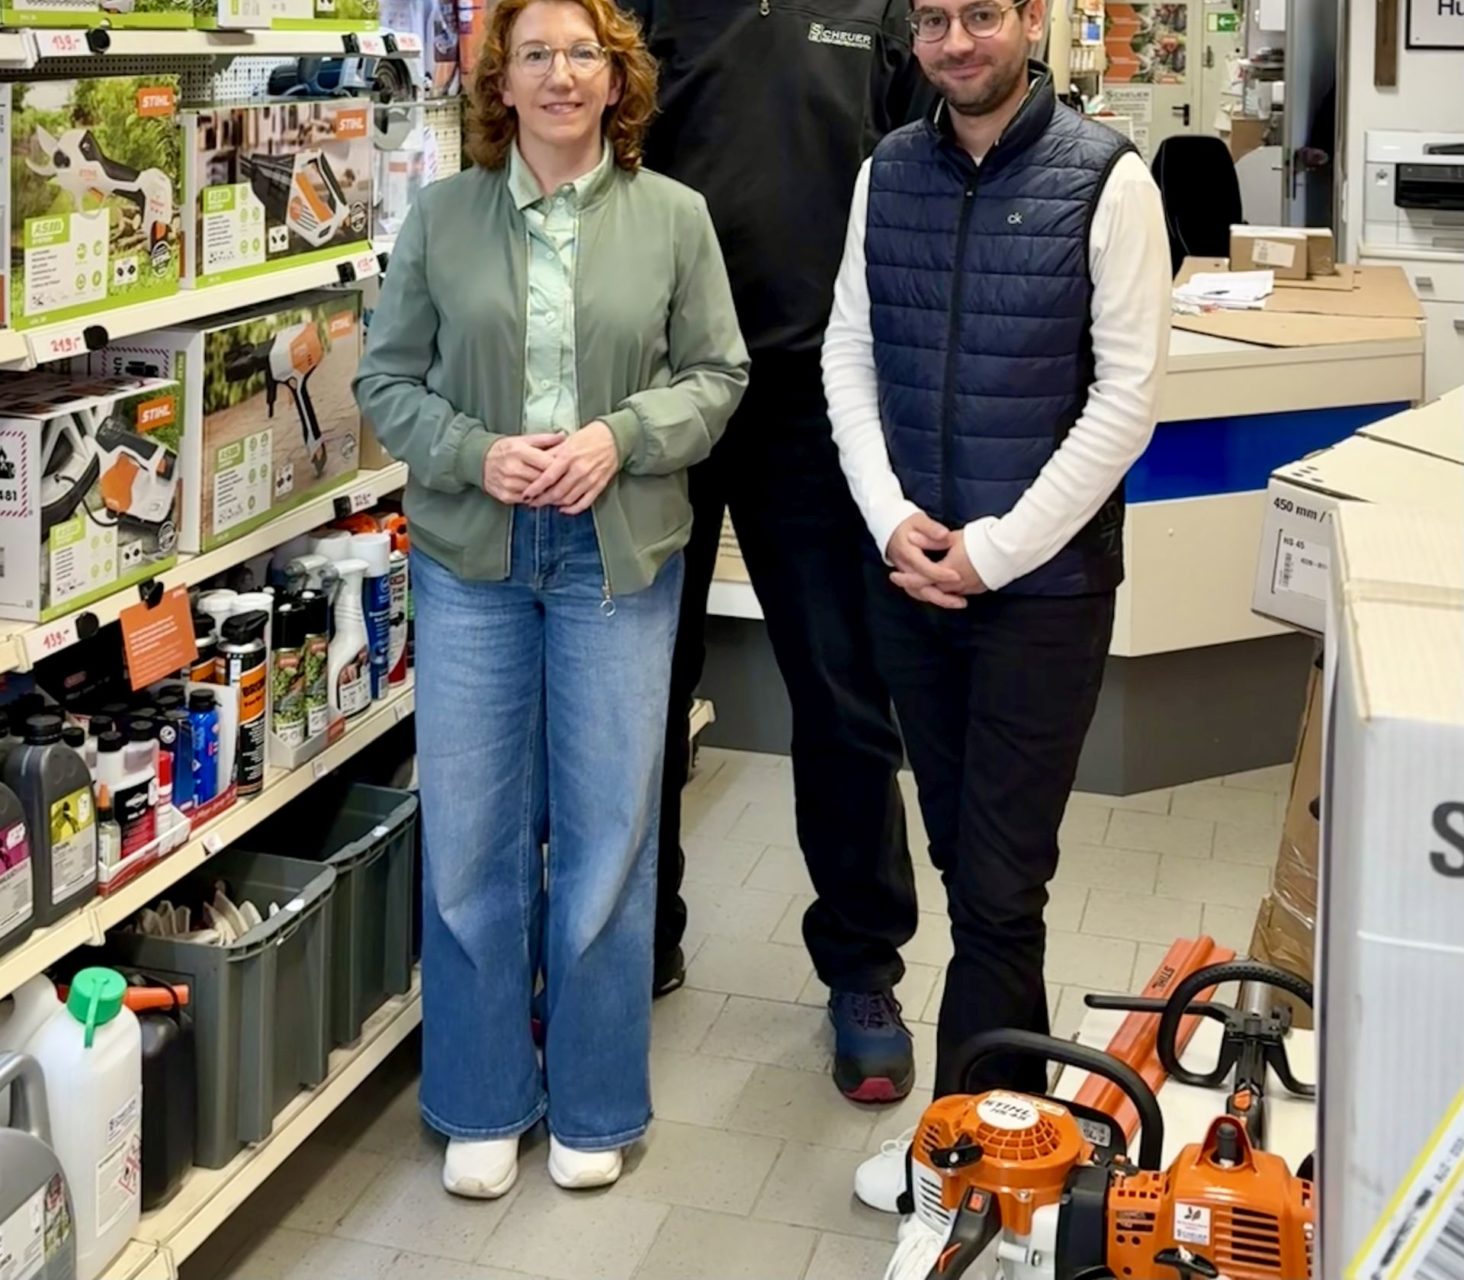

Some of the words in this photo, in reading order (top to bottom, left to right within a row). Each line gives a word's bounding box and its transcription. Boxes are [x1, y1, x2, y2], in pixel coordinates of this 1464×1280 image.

[808, 22, 872, 44] SCHEUER
[141, 94, 170, 109] STIHL
[339, 118, 364, 132] STIHL
[142, 404, 172, 424] STIHL
[1274, 497, 1294, 513] 450
[1296, 505, 1318, 520] mm
[1151, 965, 1176, 992] STIHL
